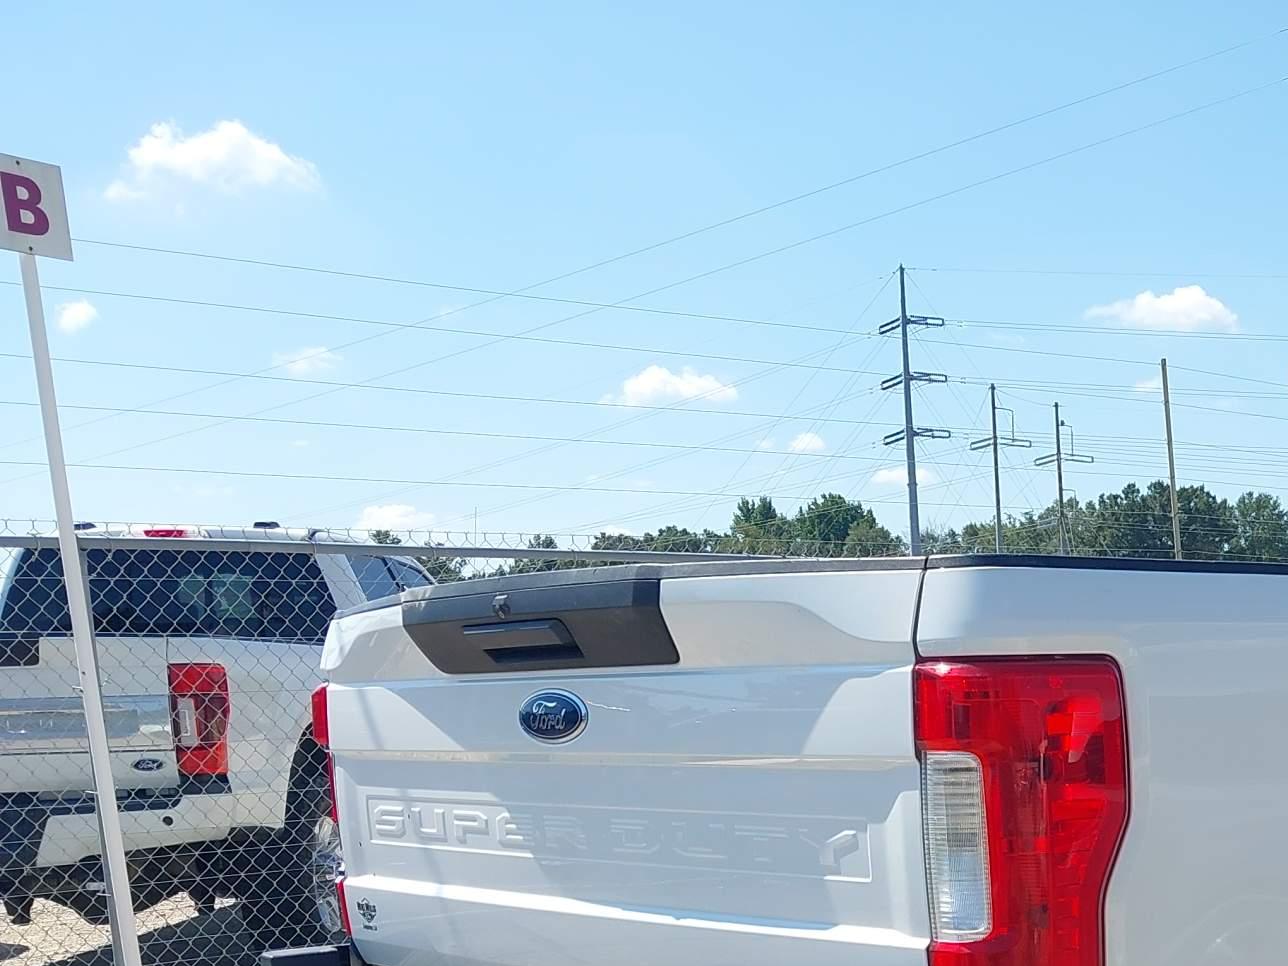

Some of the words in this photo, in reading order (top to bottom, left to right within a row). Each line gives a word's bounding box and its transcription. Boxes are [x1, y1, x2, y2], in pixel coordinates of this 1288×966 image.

[0, 171, 50, 235] B
[530, 700, 567, 730] Ford
[374, 805, 588, 850] SUPER
[608, 818, 859, 875] DUTY
